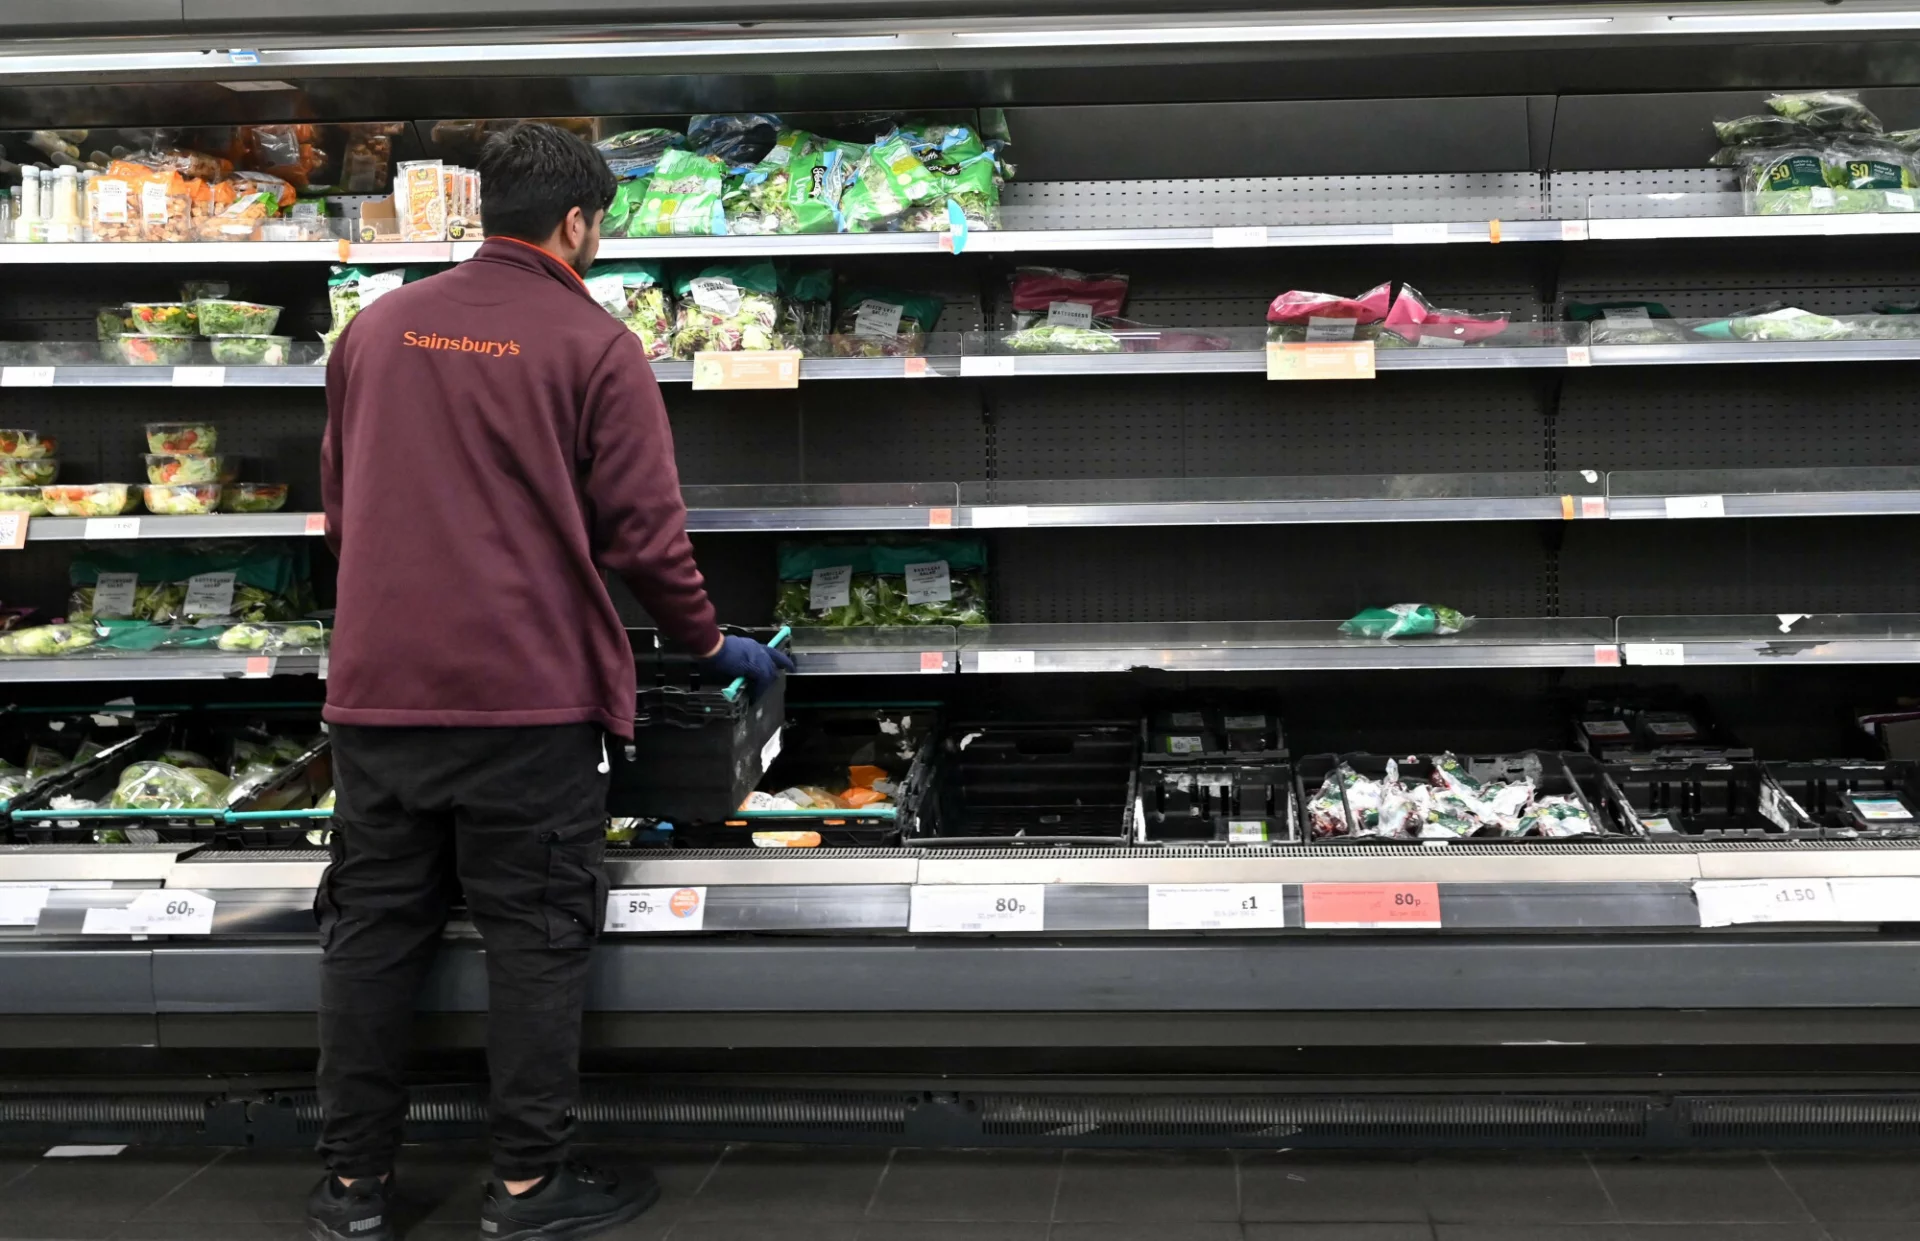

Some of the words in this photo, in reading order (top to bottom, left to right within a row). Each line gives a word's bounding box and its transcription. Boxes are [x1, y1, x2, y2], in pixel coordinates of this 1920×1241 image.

[403, 330, 521, 358] Sainsbury's
[995, 898, 1026, 914] 80p
[1241, 896, 1258, 910] £1
[1395, 893, 1421, 906] 80p
[166, 900, 195, 917] 60p
[629, 901, 653, 915] 59p
